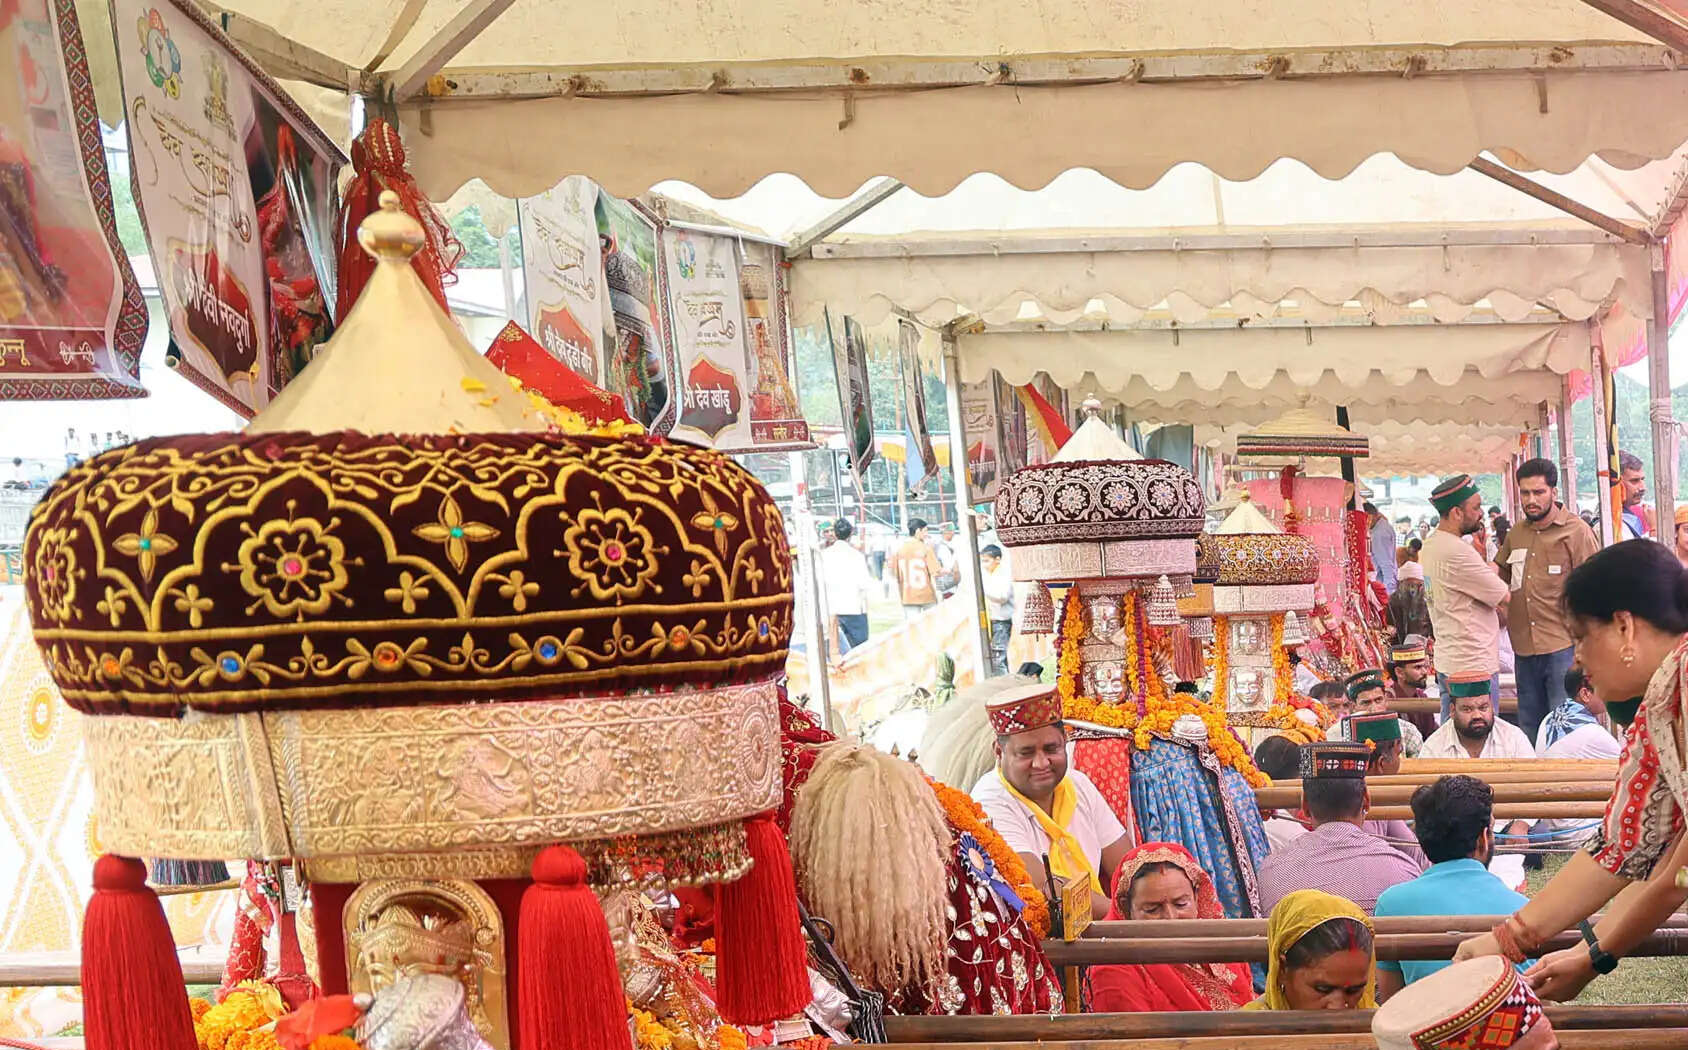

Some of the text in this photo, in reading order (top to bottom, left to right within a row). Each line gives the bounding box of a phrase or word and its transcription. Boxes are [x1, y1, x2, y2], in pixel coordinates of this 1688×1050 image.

[218, 299, 251, 354] नवदुर्गा
[695, 383, 710, 410] देव
[898, 558, 927, 589] 16
